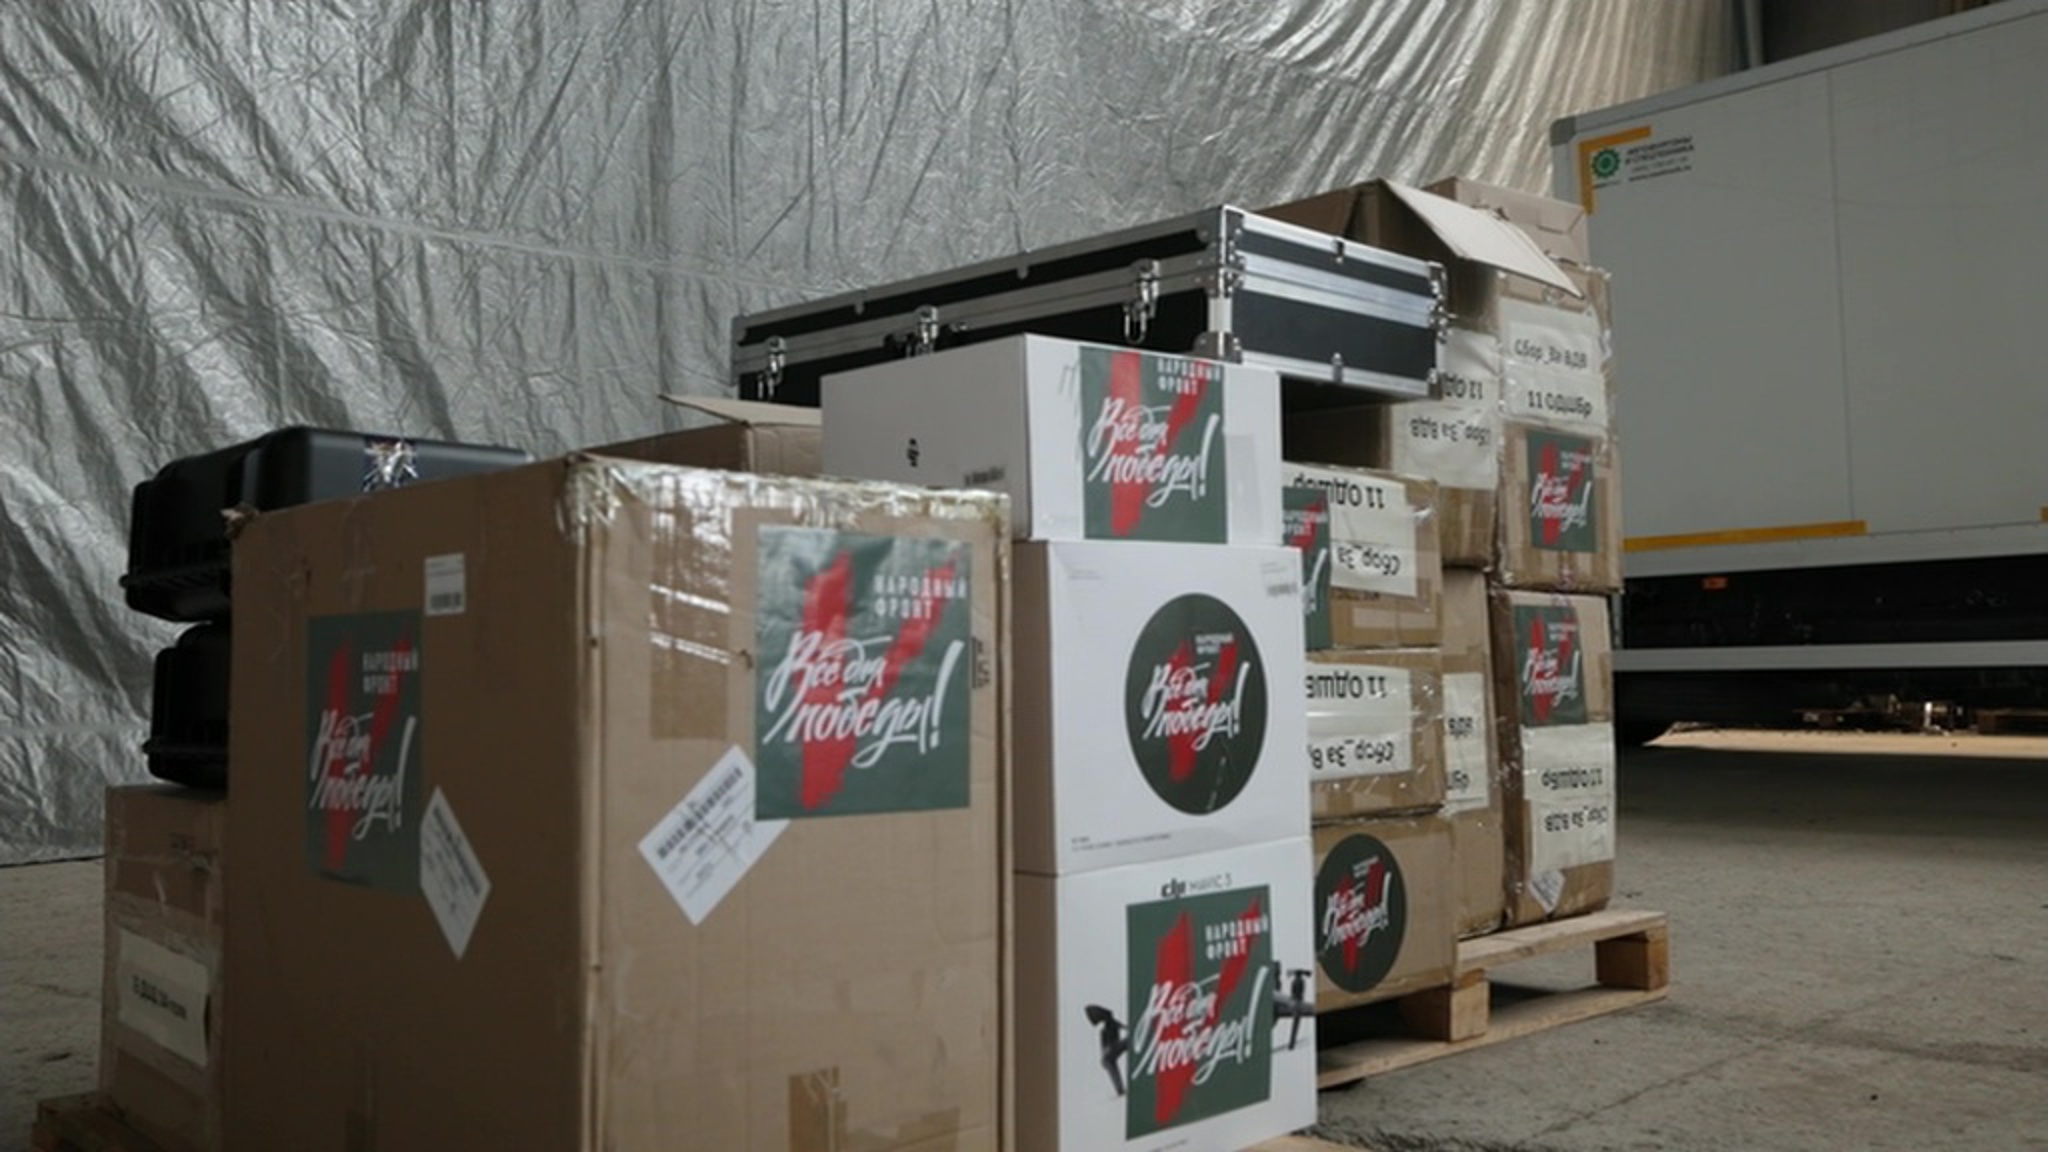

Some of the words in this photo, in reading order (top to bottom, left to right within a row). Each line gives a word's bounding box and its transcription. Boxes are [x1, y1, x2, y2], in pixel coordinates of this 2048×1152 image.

[1158, 375, 1198, 395] ФРОНТ
[1528, 391, 1543, 409] 11
[1366, 486, 1385, 509] 11
[874, 574, 967, 599] НАРОДНЫЙ
[875, 599, 934, 620] ФРОНТ
[1367, 676, 1387, 698] 11
[785, 639, 965, 769] победы!
[1206, 938, 1247, 960] ФРОНТ
